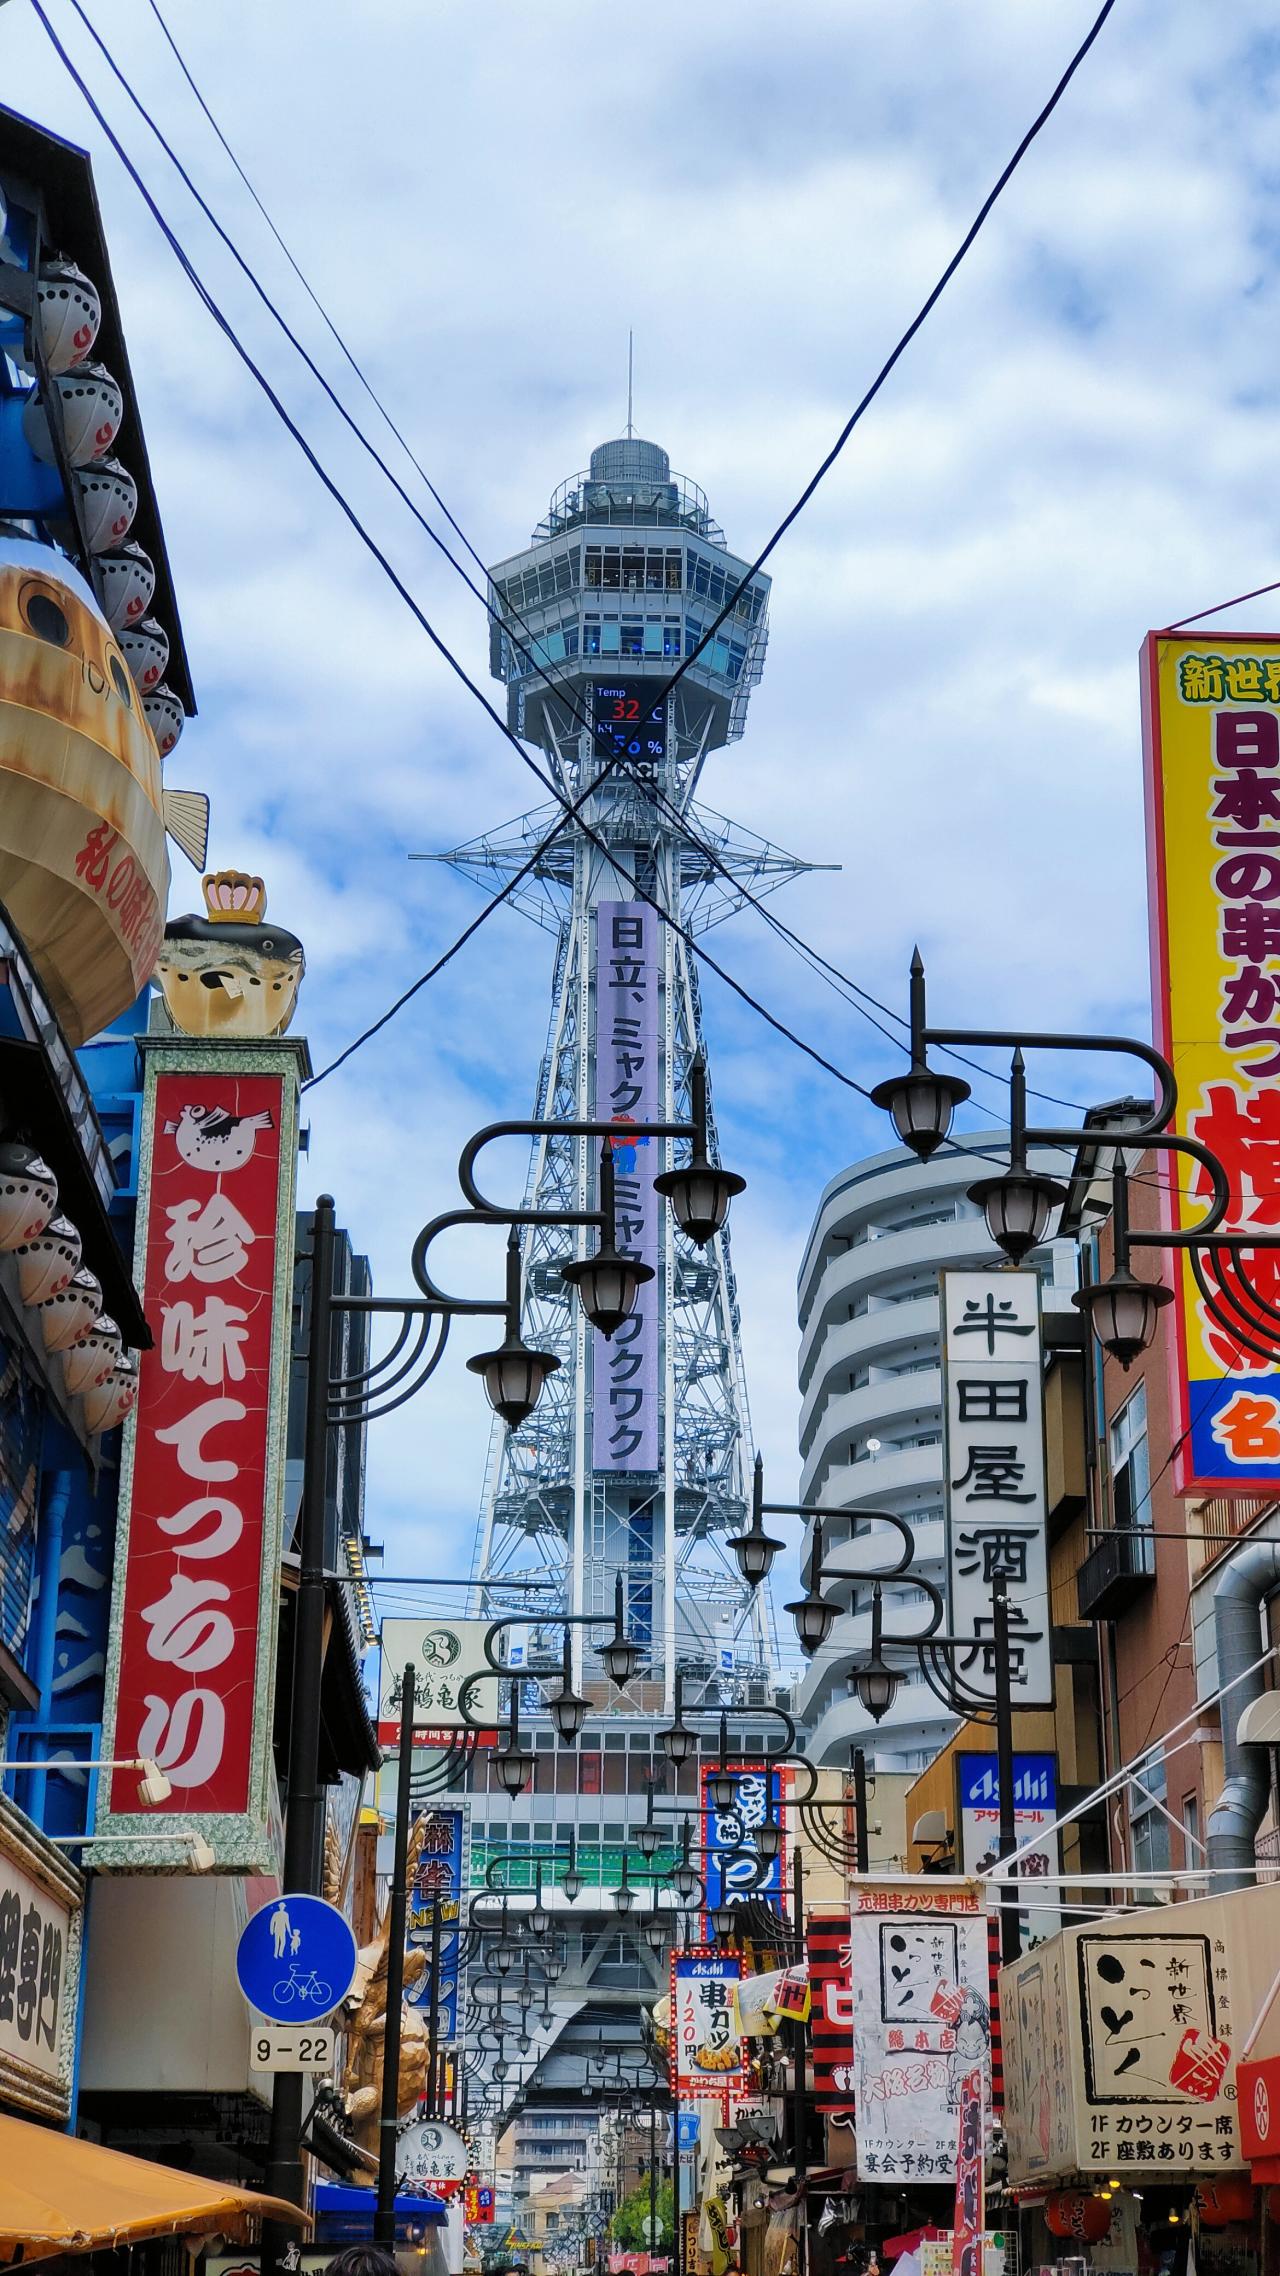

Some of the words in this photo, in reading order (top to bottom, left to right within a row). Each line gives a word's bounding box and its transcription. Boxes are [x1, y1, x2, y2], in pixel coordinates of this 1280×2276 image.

[597, 687, 626, 700] Temp
[612, 700, 640, 719] 32
[647, 741, 663, 754] %
[582, 761, 676, 778] HITACHI
[1212, 711, 1280, 1078] 日本一の串かつ
[952, 1293, 1044, 1676] 半田屋酒店
[973, 1810, 1044, 1823] アサビール
[858, 1893, 980, 1912] 元祖串カツ専門店
[410, 1900, 459, 1929] NEW
[692, 1963, 723, 1976] Asahi
[1091, 2115, 1108, 2132] 1F
[1116, 2114, 1233, 2134] カウンター席
[1091, 2141, 1109, 2159] 2F
[1117, 2140, 1235, 2161] 座敷あります
[864, 2152, 957, 2175] 宴会予約受
